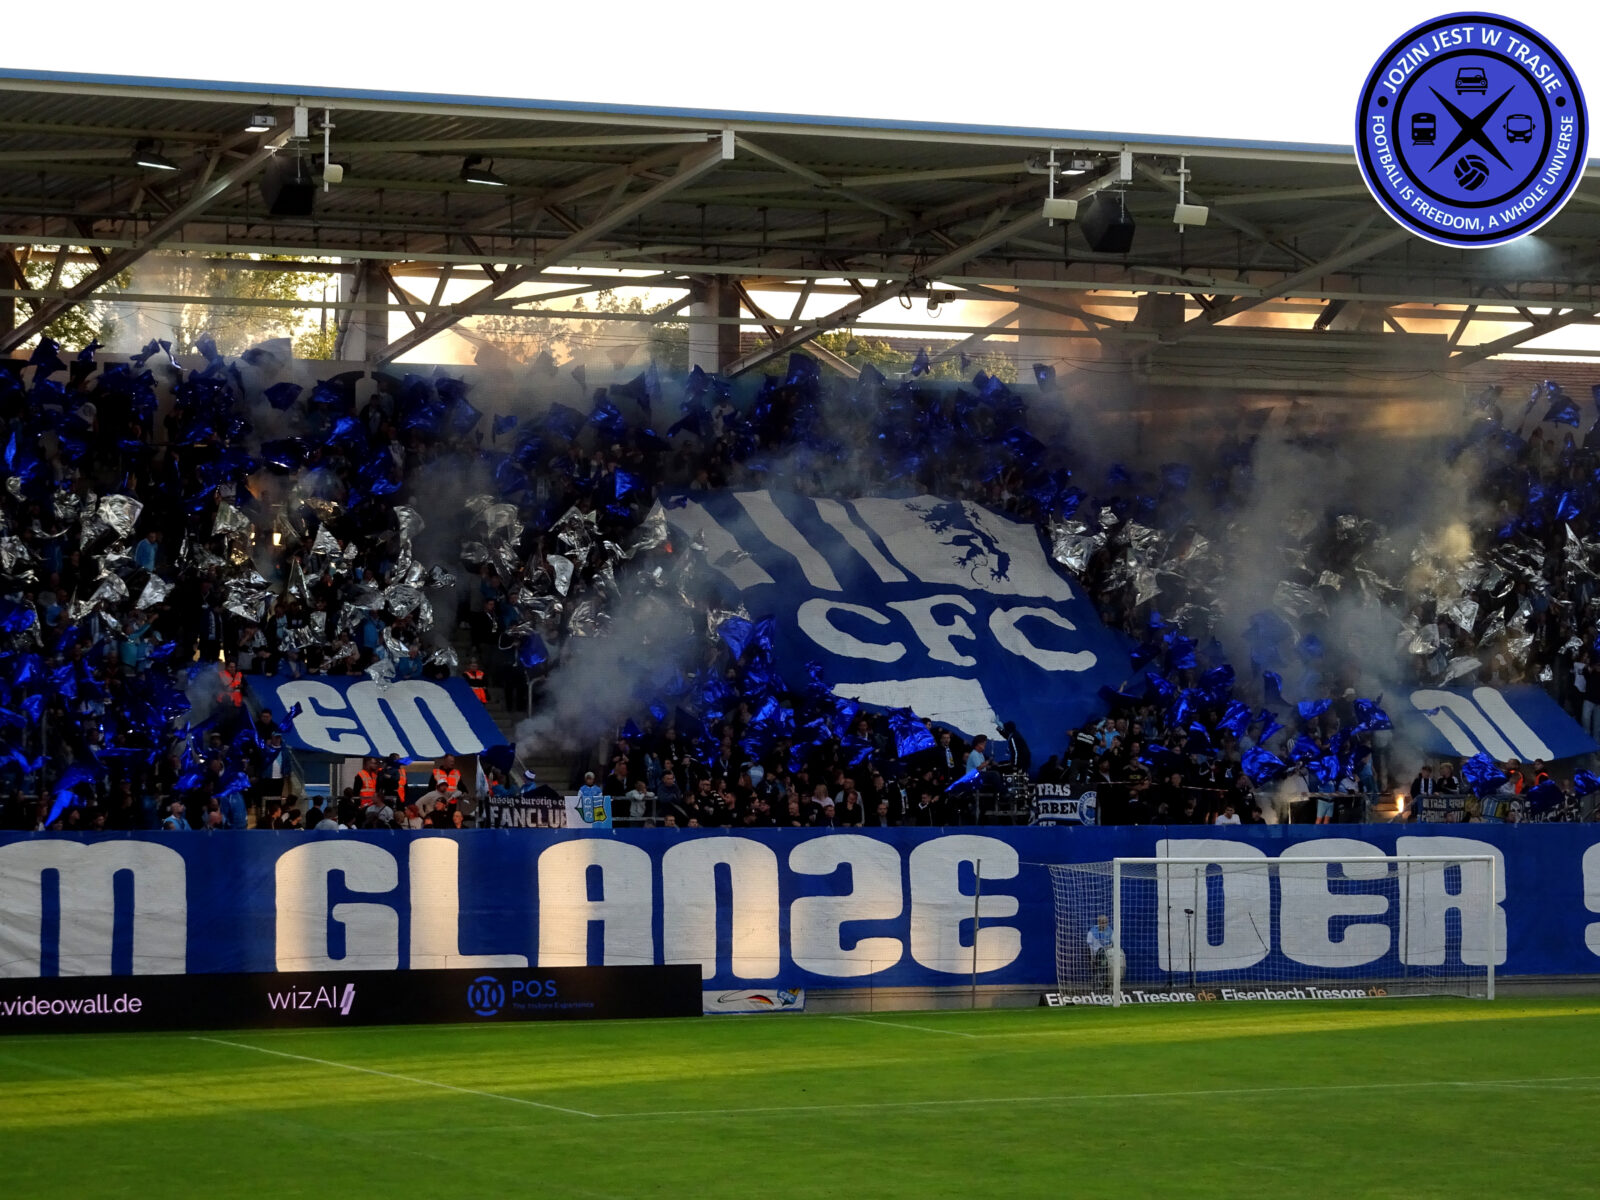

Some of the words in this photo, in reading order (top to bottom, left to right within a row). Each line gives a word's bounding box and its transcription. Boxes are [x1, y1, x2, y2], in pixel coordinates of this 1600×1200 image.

[797, 594, 1098, 672] CFC
[1034, 783, 1072, 797] TRAS
[1038, 802, 1078, 814] RBEN
[275, 834, 1022, 979] GLANZE
[1156, 836, 1508, 972] DER
[1045, 990, 1133, 1007] Eisenbah
[1221, 986, 1305, 1001] Eisenbach
[0, 994, 142, 1017] .videowall.de
